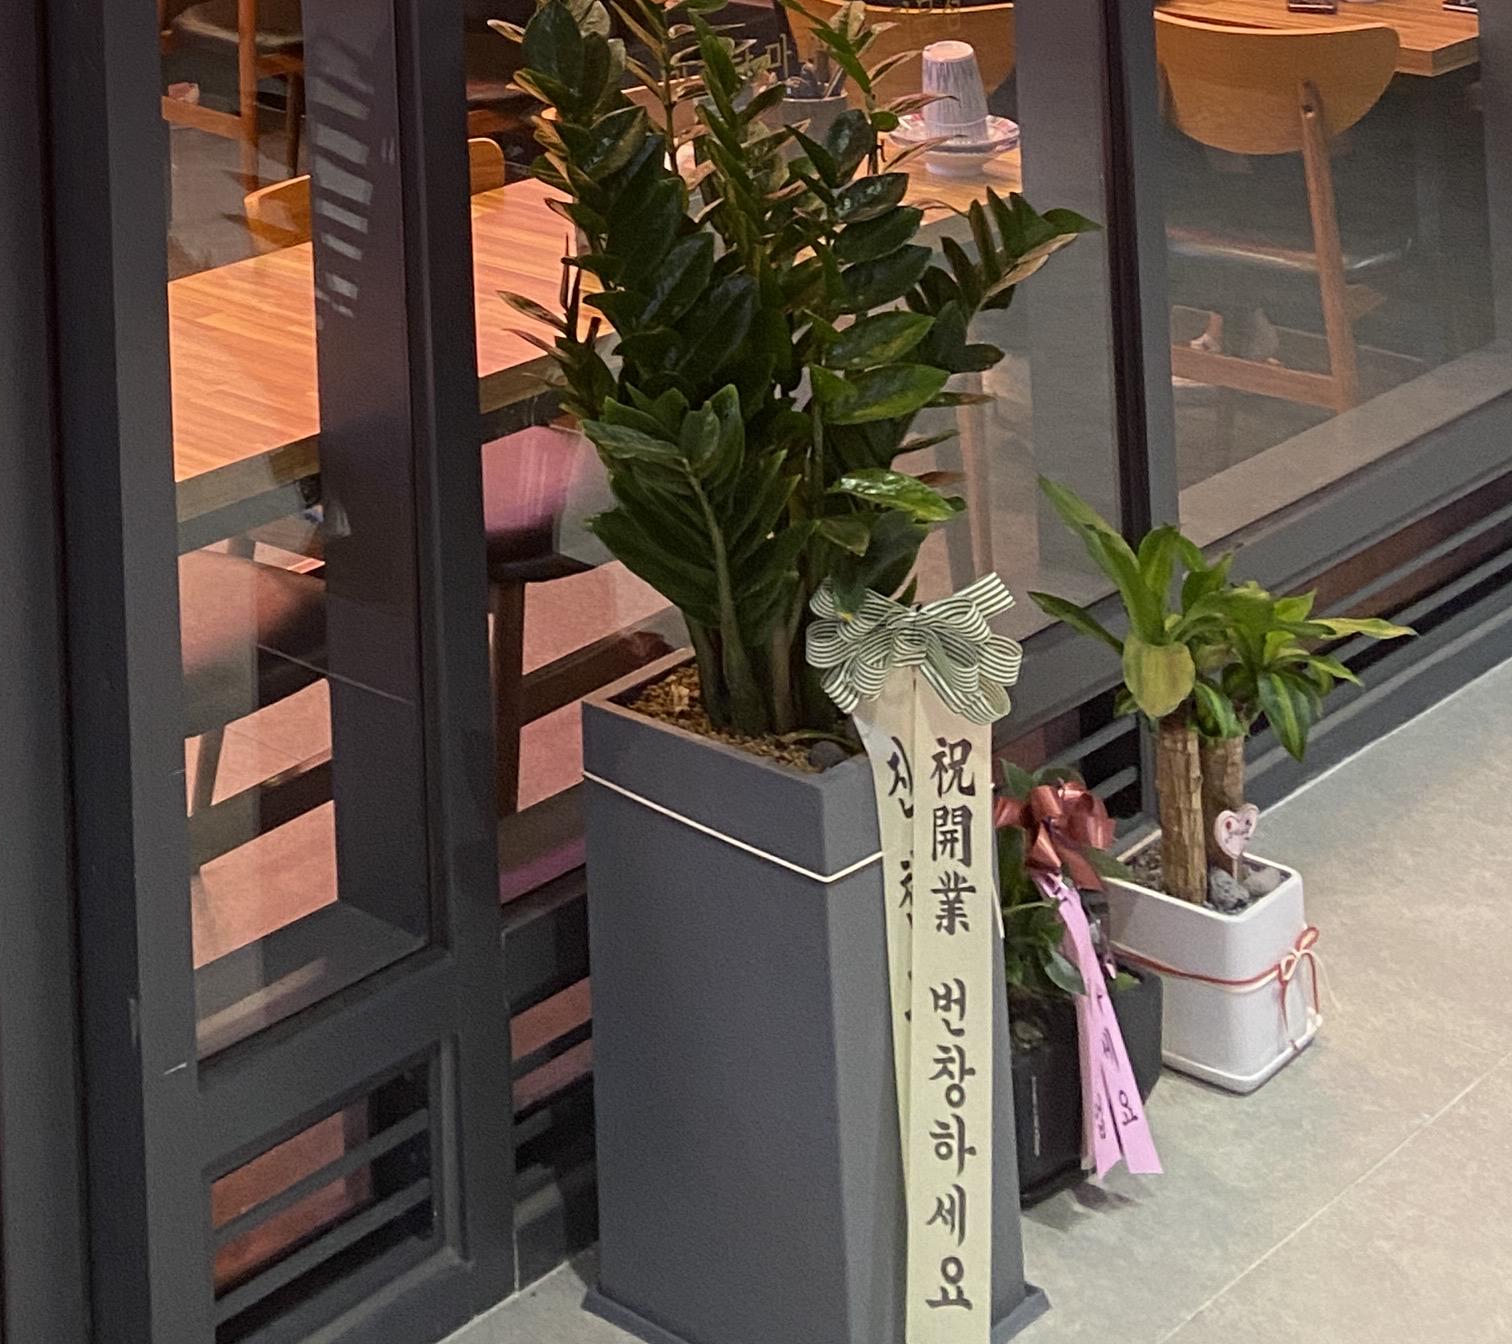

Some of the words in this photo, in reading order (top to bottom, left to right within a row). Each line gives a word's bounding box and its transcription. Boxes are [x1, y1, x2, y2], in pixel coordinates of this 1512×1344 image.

[929, 735, 977, 935] 祝開業
[924, 977, 977, 1311] 번창하세요
